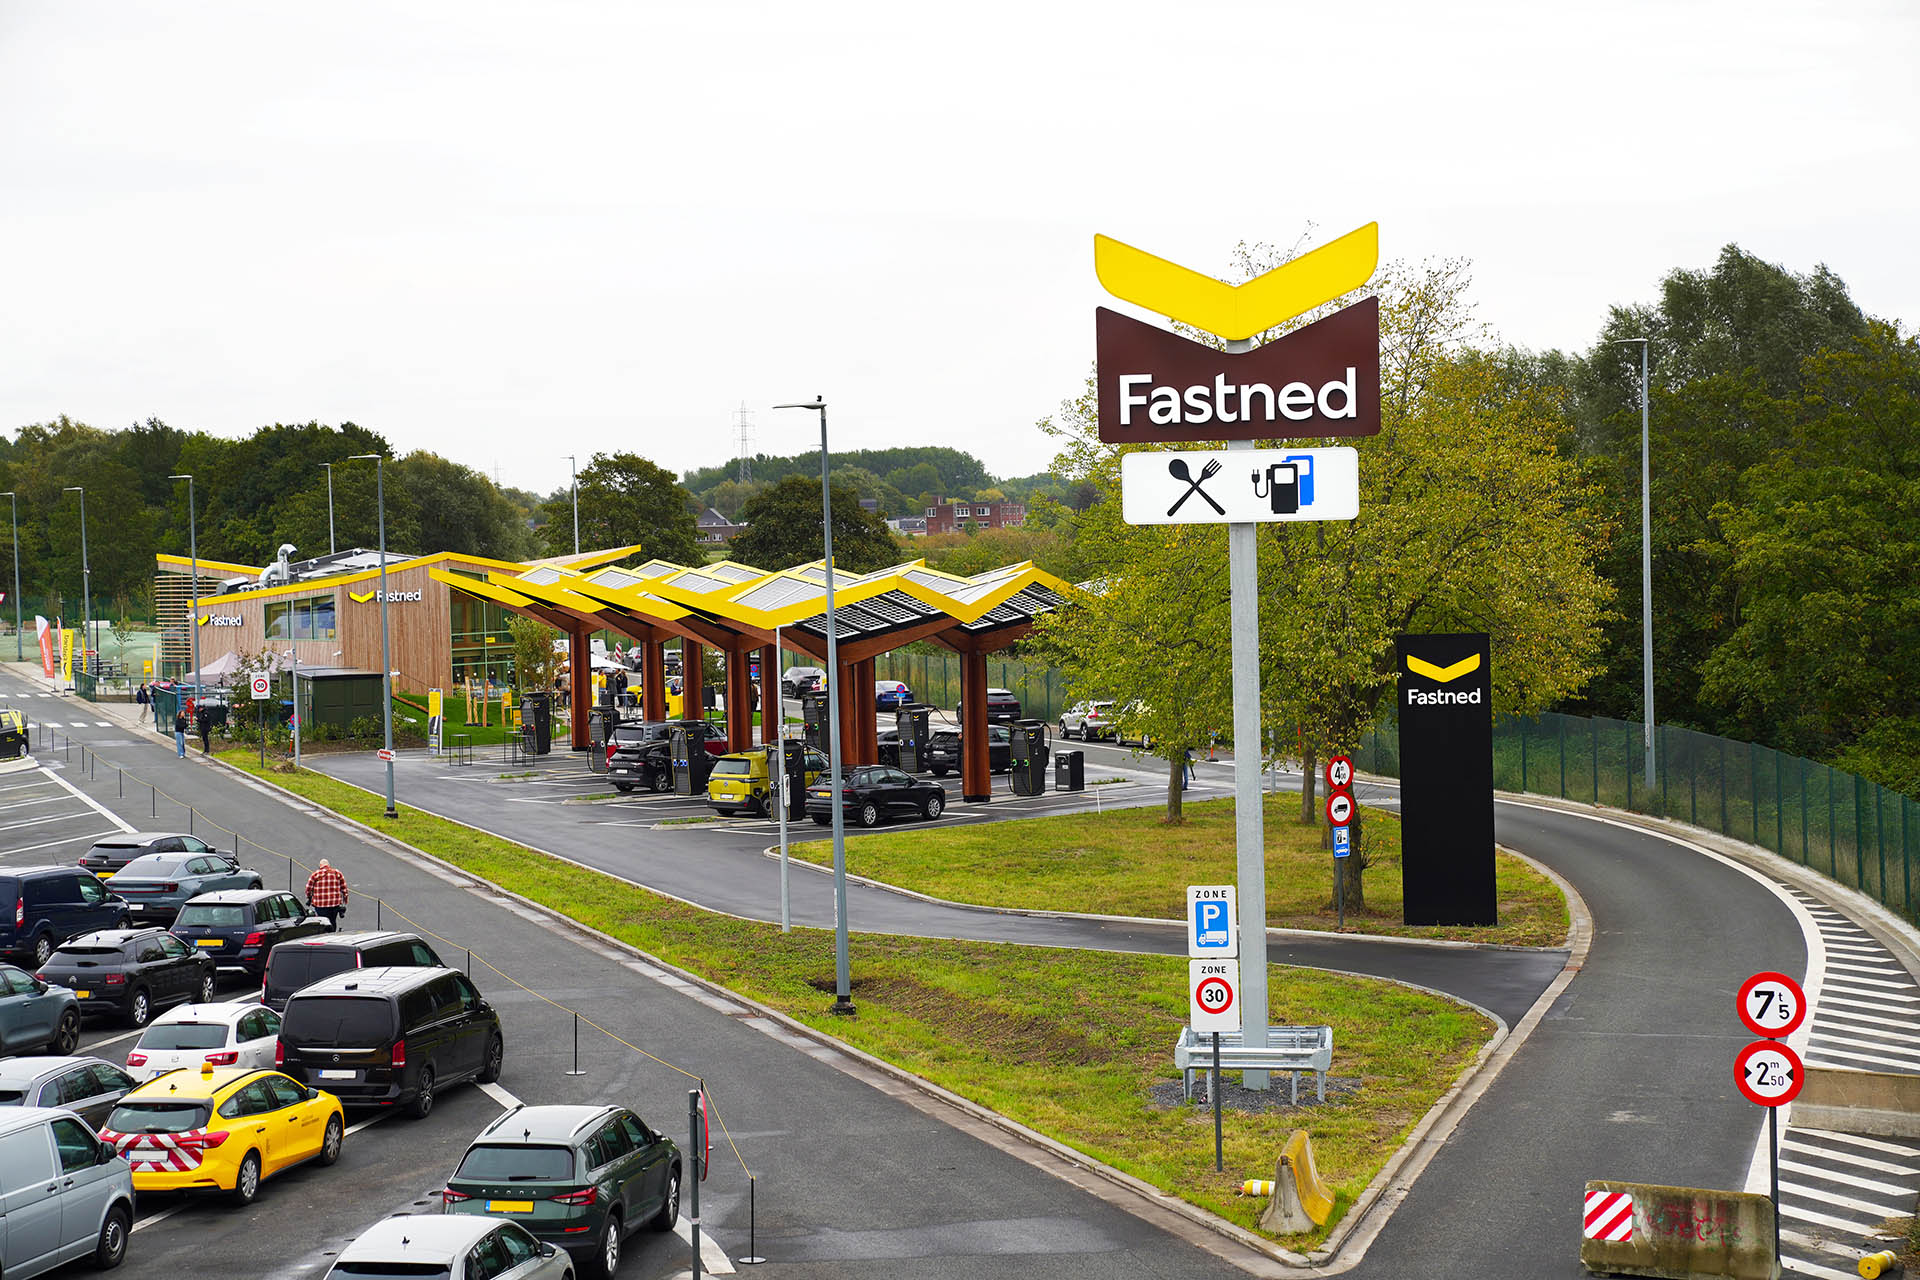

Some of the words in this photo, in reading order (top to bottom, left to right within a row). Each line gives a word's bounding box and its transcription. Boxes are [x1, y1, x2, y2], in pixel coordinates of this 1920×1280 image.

[1119, 367, 1357, 425] Fastned
[210, 613, 242, 626] Fastned
[1407, 687, 1481, 705] Fastned
[1195, 890, 1227, 899] ZONE
[1202, 904, 1220, 929] P
[1201, 966, 1227, 974] ZONE
[1205, 989, 1224, 1002] 30
